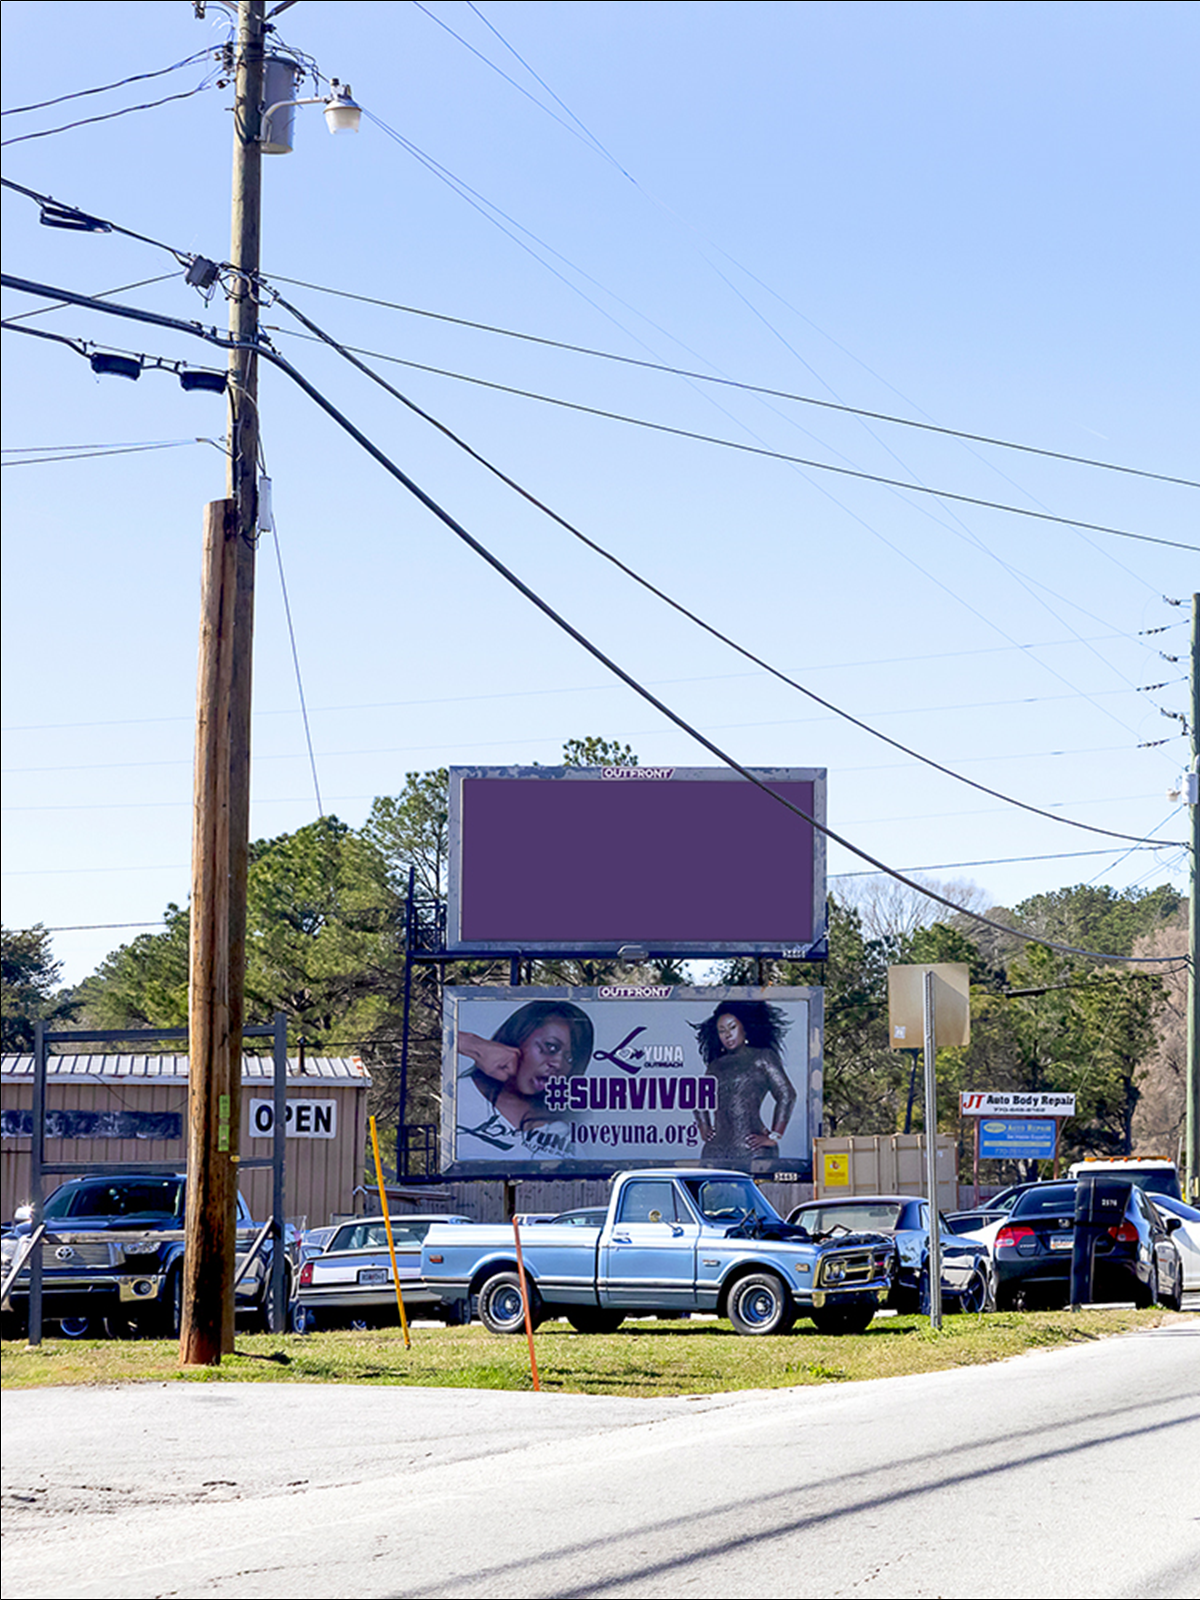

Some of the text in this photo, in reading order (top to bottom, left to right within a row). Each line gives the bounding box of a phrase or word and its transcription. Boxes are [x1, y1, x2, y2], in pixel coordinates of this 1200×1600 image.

[603, 767, 673, 779] OUTFRONT
[600, 986, 670, 997] OUTFRONT
[545, 1076, 717, 1111] #SURVIVOR
[963, 1094, 1074, 1109] JT Auto Body Repair
[570, 1121, 699, 1148] loveyuna.org
